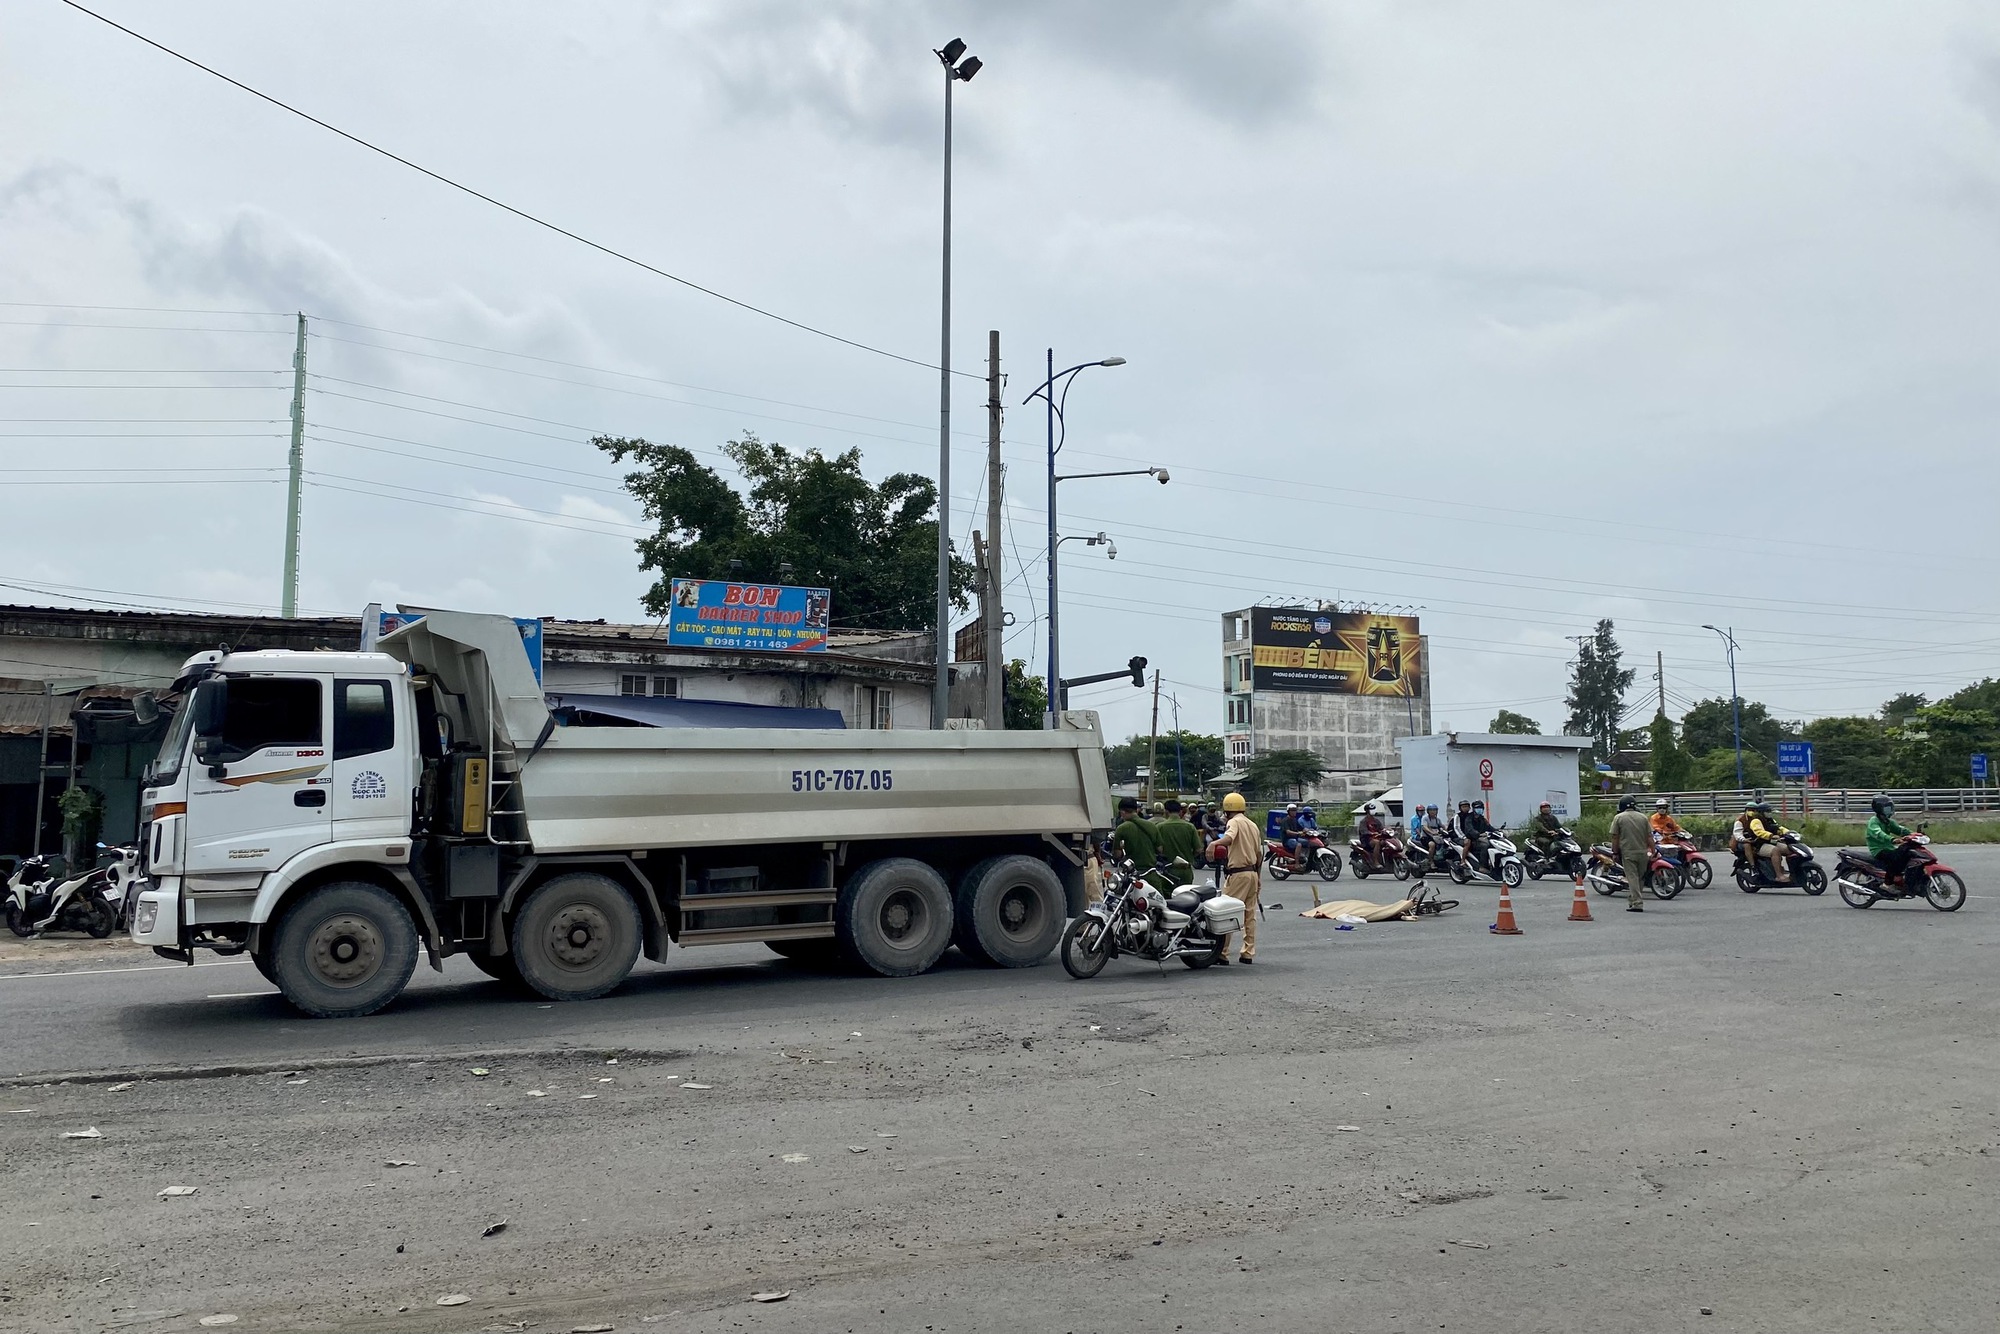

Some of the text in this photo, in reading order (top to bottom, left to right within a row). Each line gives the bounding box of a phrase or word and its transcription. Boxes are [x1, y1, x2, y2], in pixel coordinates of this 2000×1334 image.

[723, 584, 782, 607] BON
[699, 607, 803, 625] BARBER SHOP
[762, 628, 773, 637] TAI
[1270, 621, 1312, 632] ROCKSTAR
[714, 637, 788, 649] 0981 211 463
[792, 769, 893, 792] 51C-767.05
